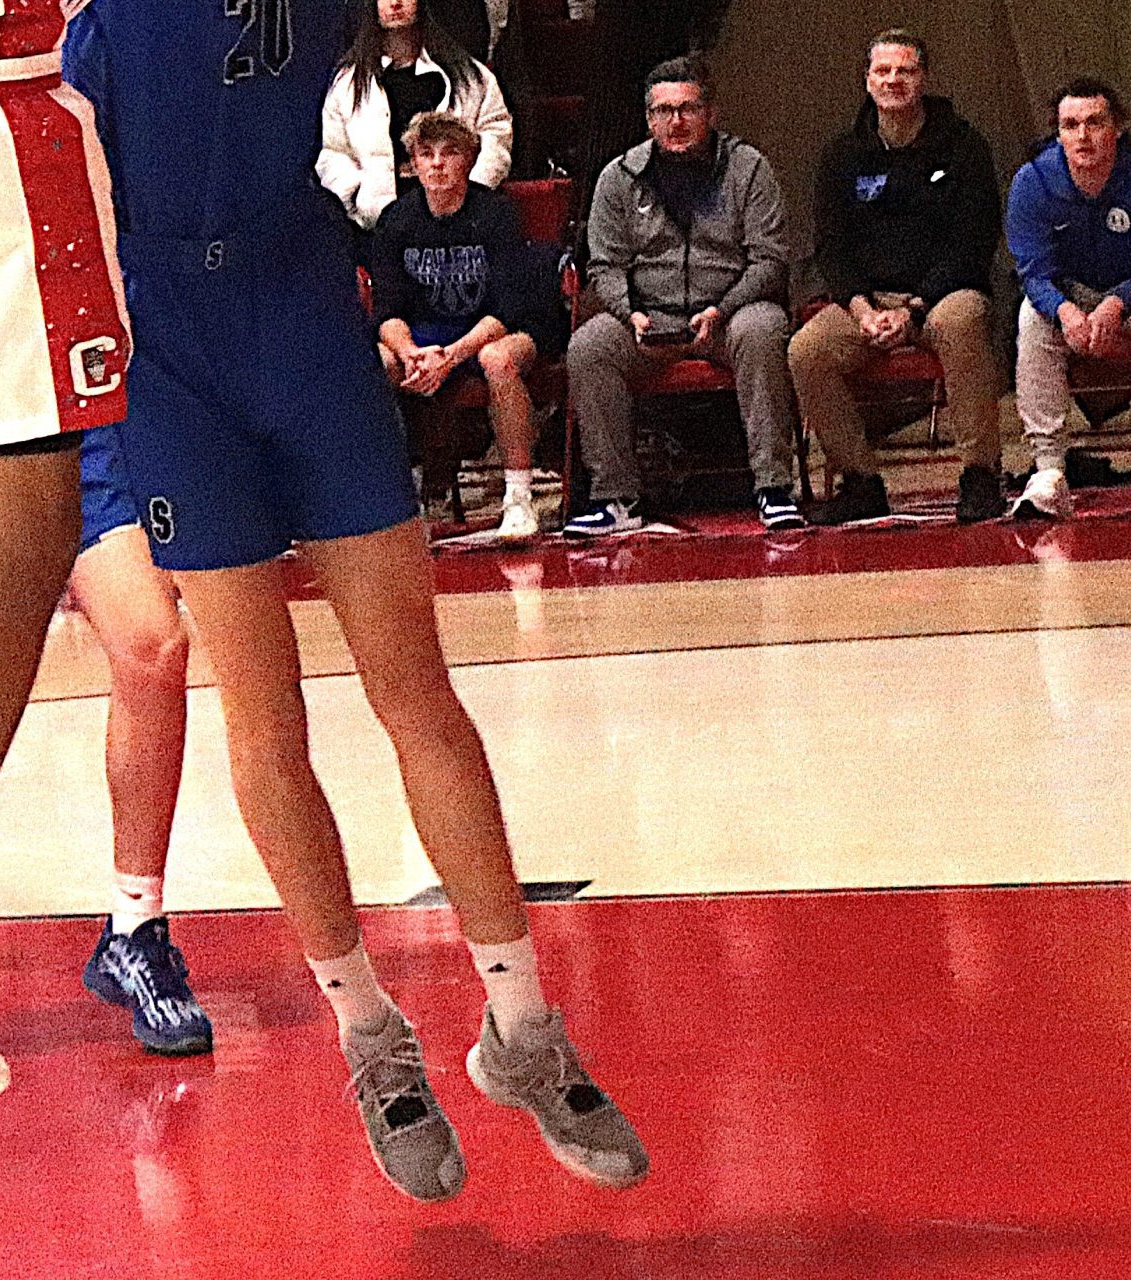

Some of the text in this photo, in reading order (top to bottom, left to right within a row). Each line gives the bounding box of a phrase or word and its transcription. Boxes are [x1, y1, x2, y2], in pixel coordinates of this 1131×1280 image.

[205, 239, 225, 271] S
[69, 335, 121, 397] C
[149, 496, 176, 543] S
